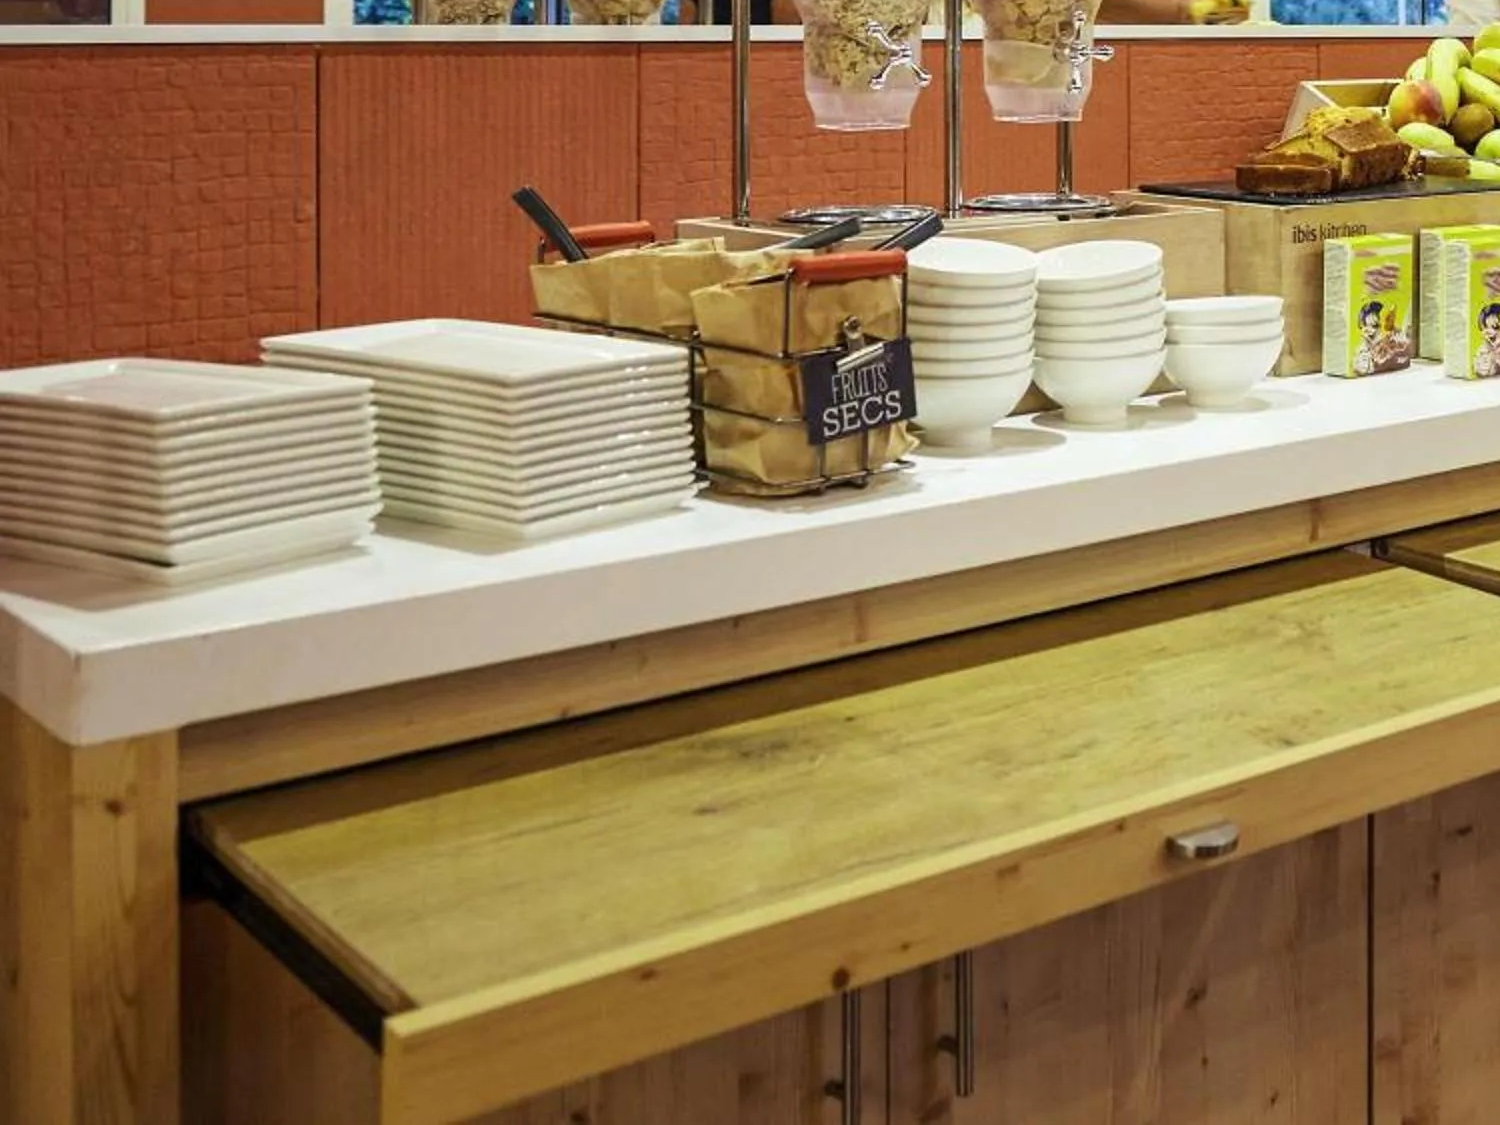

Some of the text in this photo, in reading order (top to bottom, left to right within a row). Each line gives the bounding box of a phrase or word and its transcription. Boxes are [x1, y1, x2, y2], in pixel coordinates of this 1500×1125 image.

[1292, 224, 1317, 243] ibis
[832, 363, 888, 404] FRUITS
[823, 390, 902, 436] SECS
